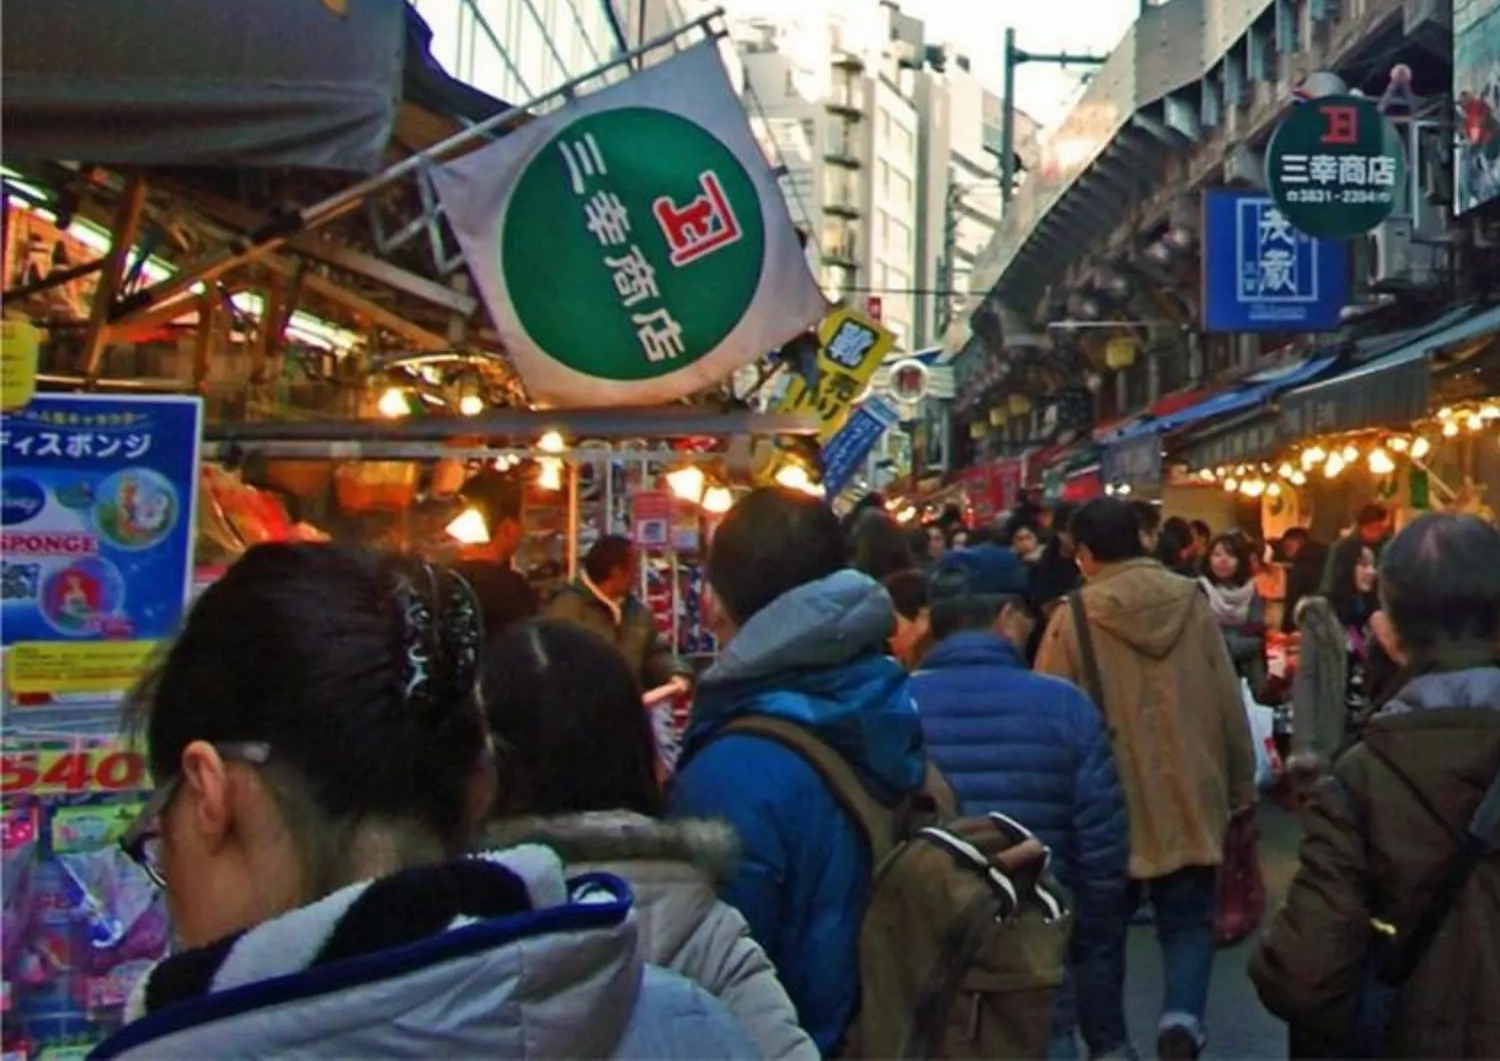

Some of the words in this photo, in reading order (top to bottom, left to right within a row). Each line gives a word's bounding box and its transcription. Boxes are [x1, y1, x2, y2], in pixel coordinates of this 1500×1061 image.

[1280, 155, 1396, 186] 三幸商店
[557, 133, 686, 363] 三幸商店
